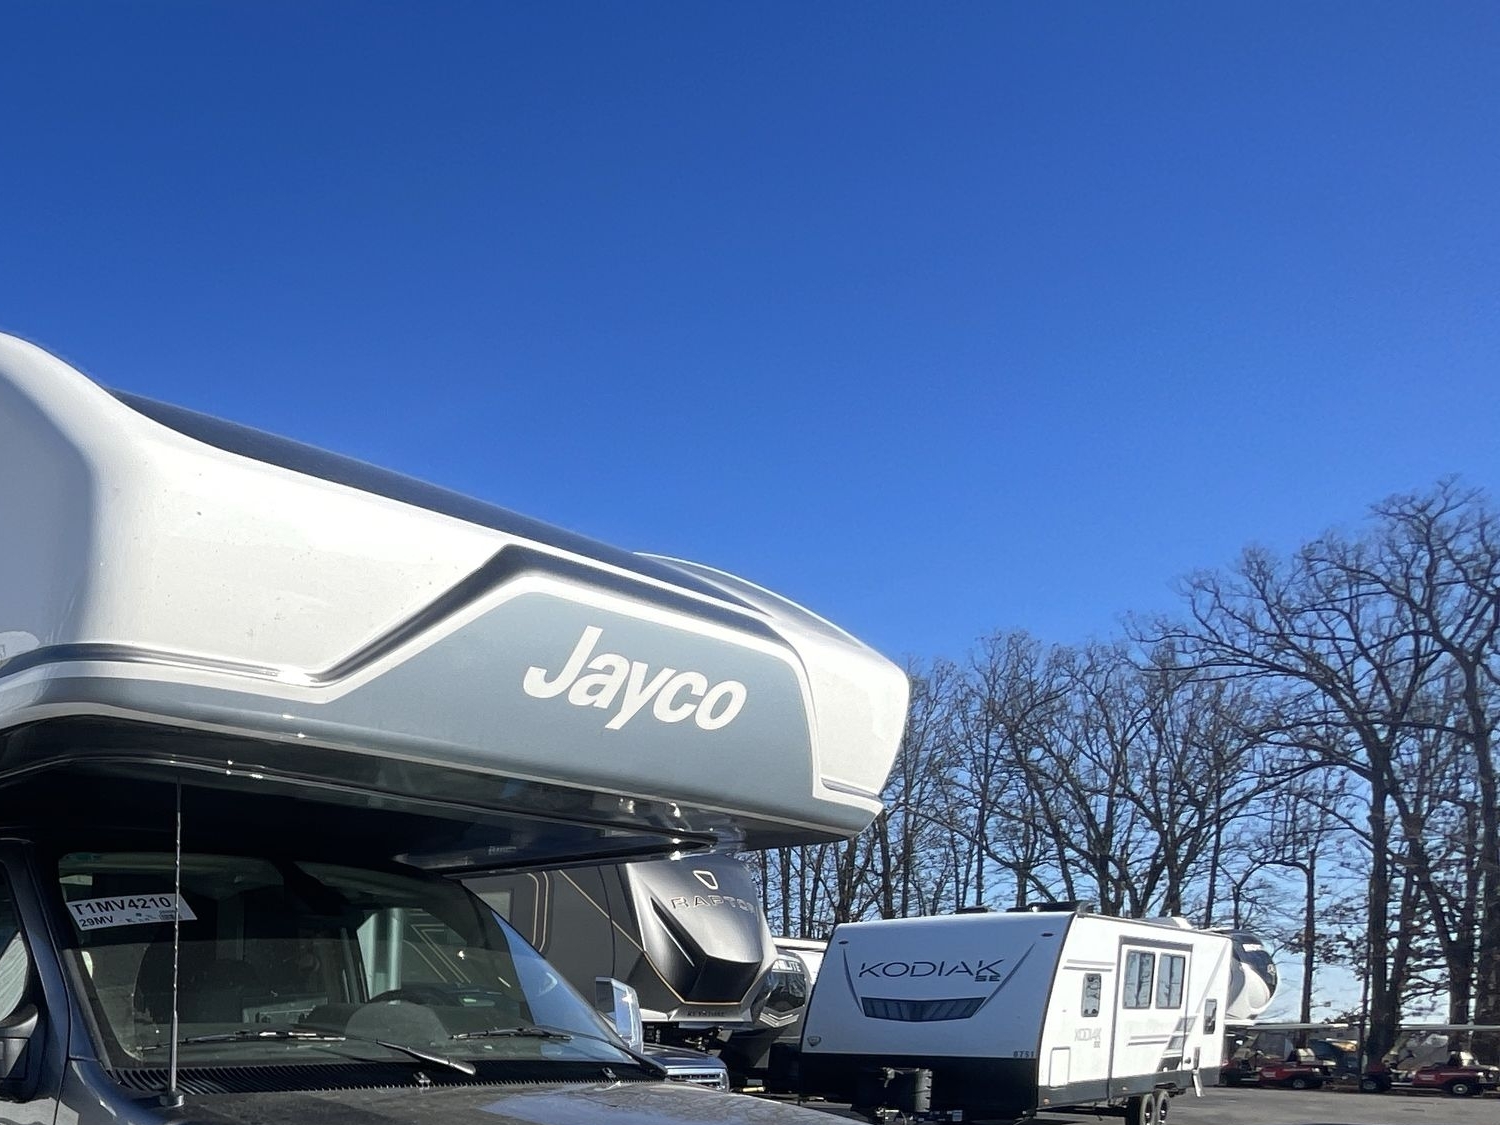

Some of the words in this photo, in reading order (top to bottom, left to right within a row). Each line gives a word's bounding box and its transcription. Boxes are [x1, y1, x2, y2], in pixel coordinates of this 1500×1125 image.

[523, 625, 748, 730] Jayco
[73, 896, 171, 915] T1MV4210
[858, 959, 1005, 978] KODIAK
[974, 974, 1001, 982] SE
